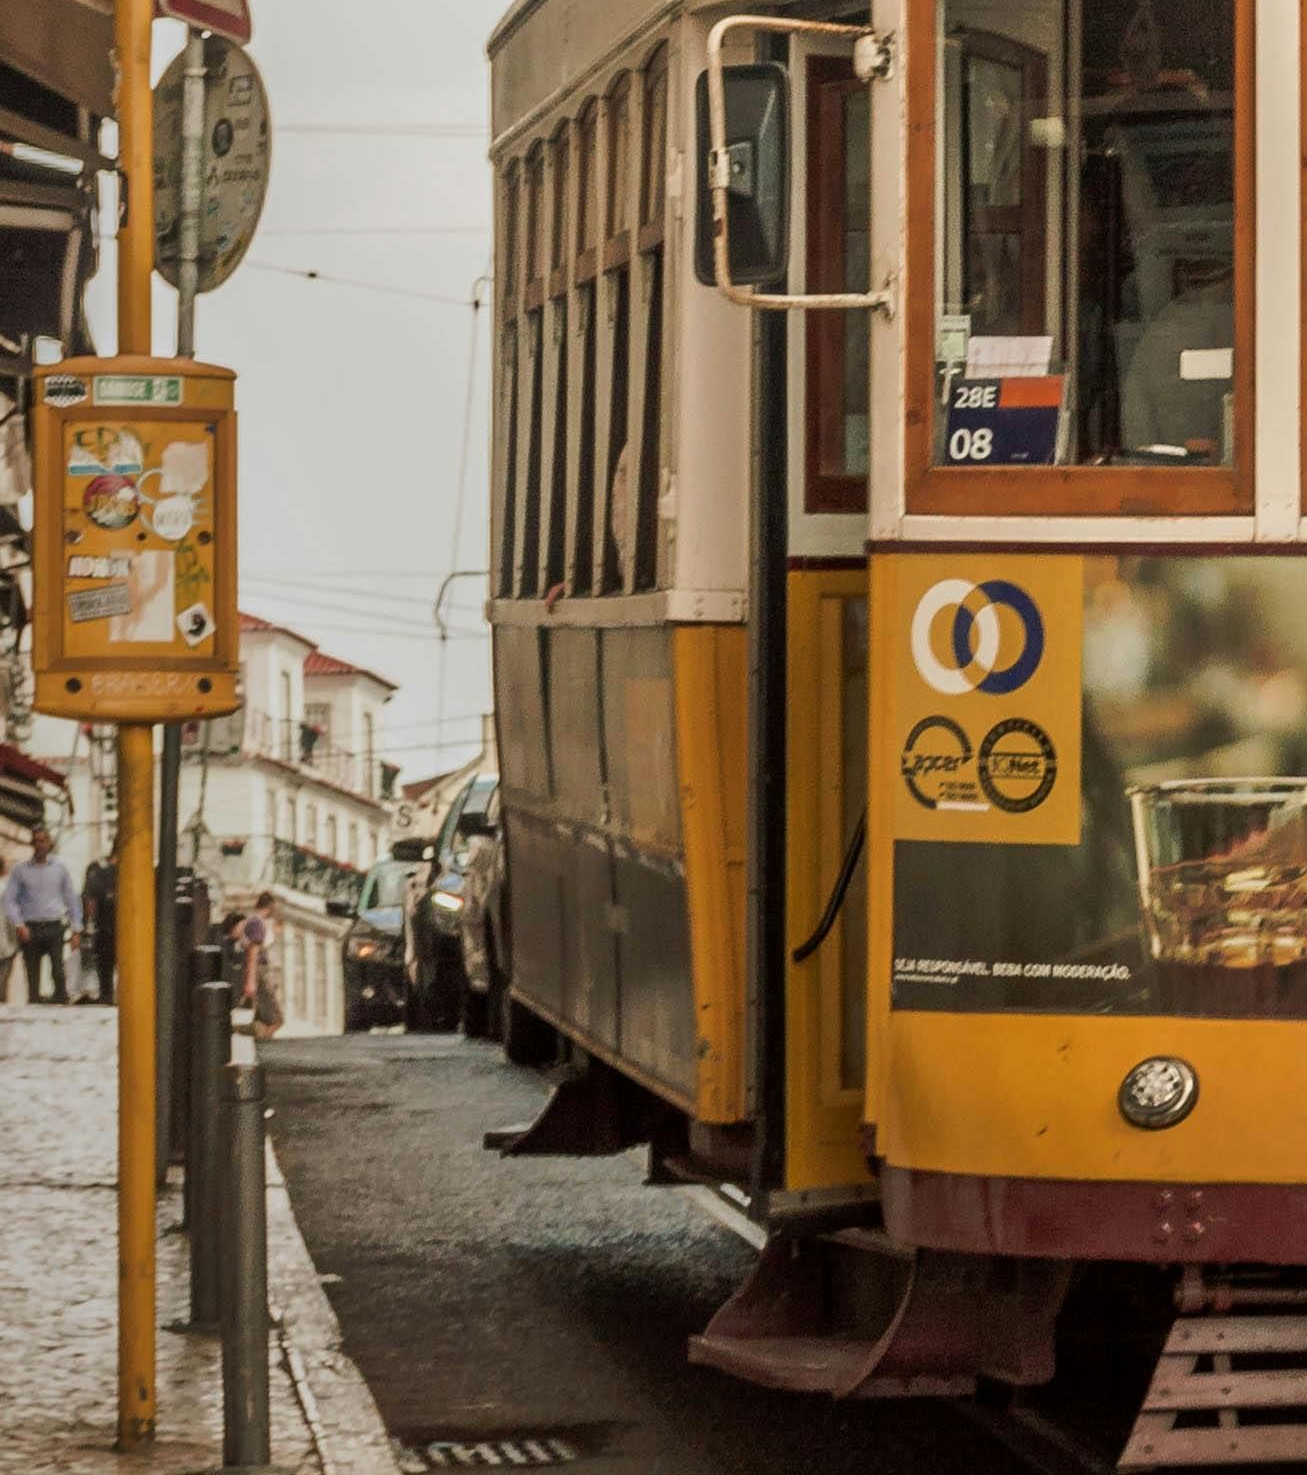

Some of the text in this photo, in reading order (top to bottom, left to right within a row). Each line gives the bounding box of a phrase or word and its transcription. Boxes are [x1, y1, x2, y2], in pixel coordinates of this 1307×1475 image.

[953, 385, 998, 409] 28E
[948, 427, 994, 461] 08
[1023, 962, 1051, 978] COM
